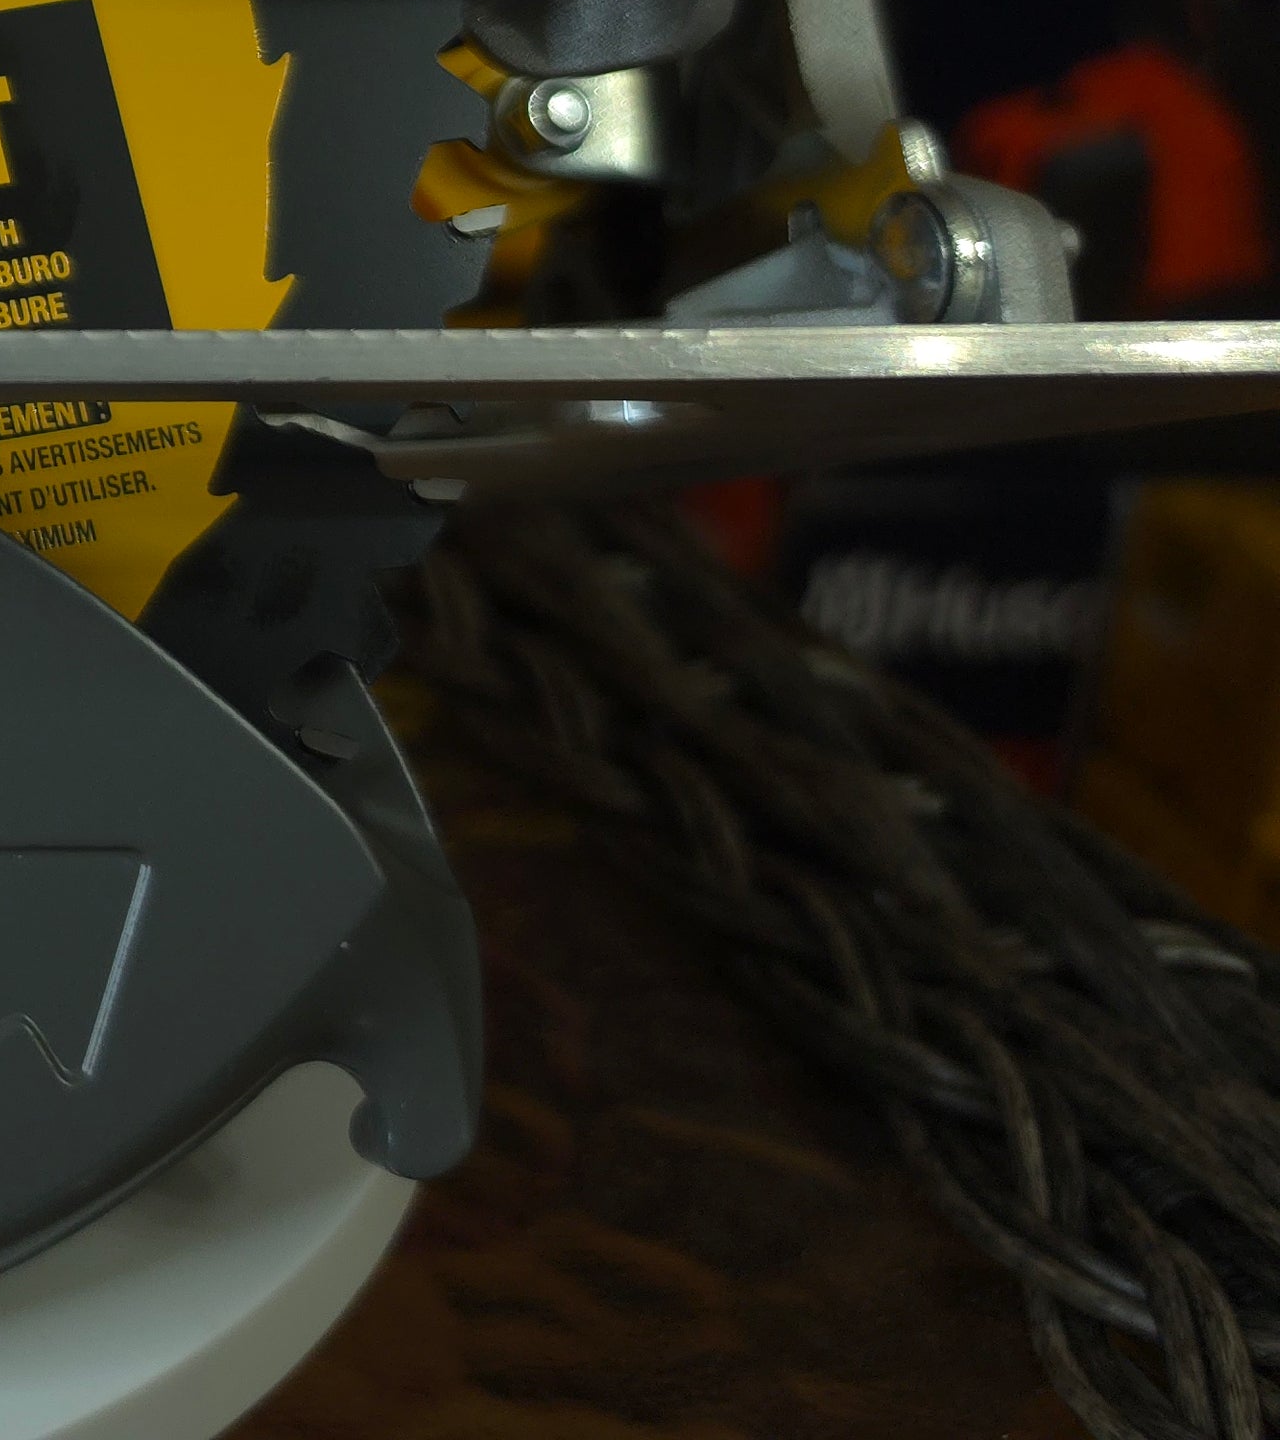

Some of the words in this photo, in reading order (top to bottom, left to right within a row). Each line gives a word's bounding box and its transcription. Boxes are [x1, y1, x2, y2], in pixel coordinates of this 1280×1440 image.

[9, 420, 203, 471] AVERTISSEMENTS
[29, 470, 157, 510] D'UTILISER.
[17, 519, 98, 551] XIMUM
